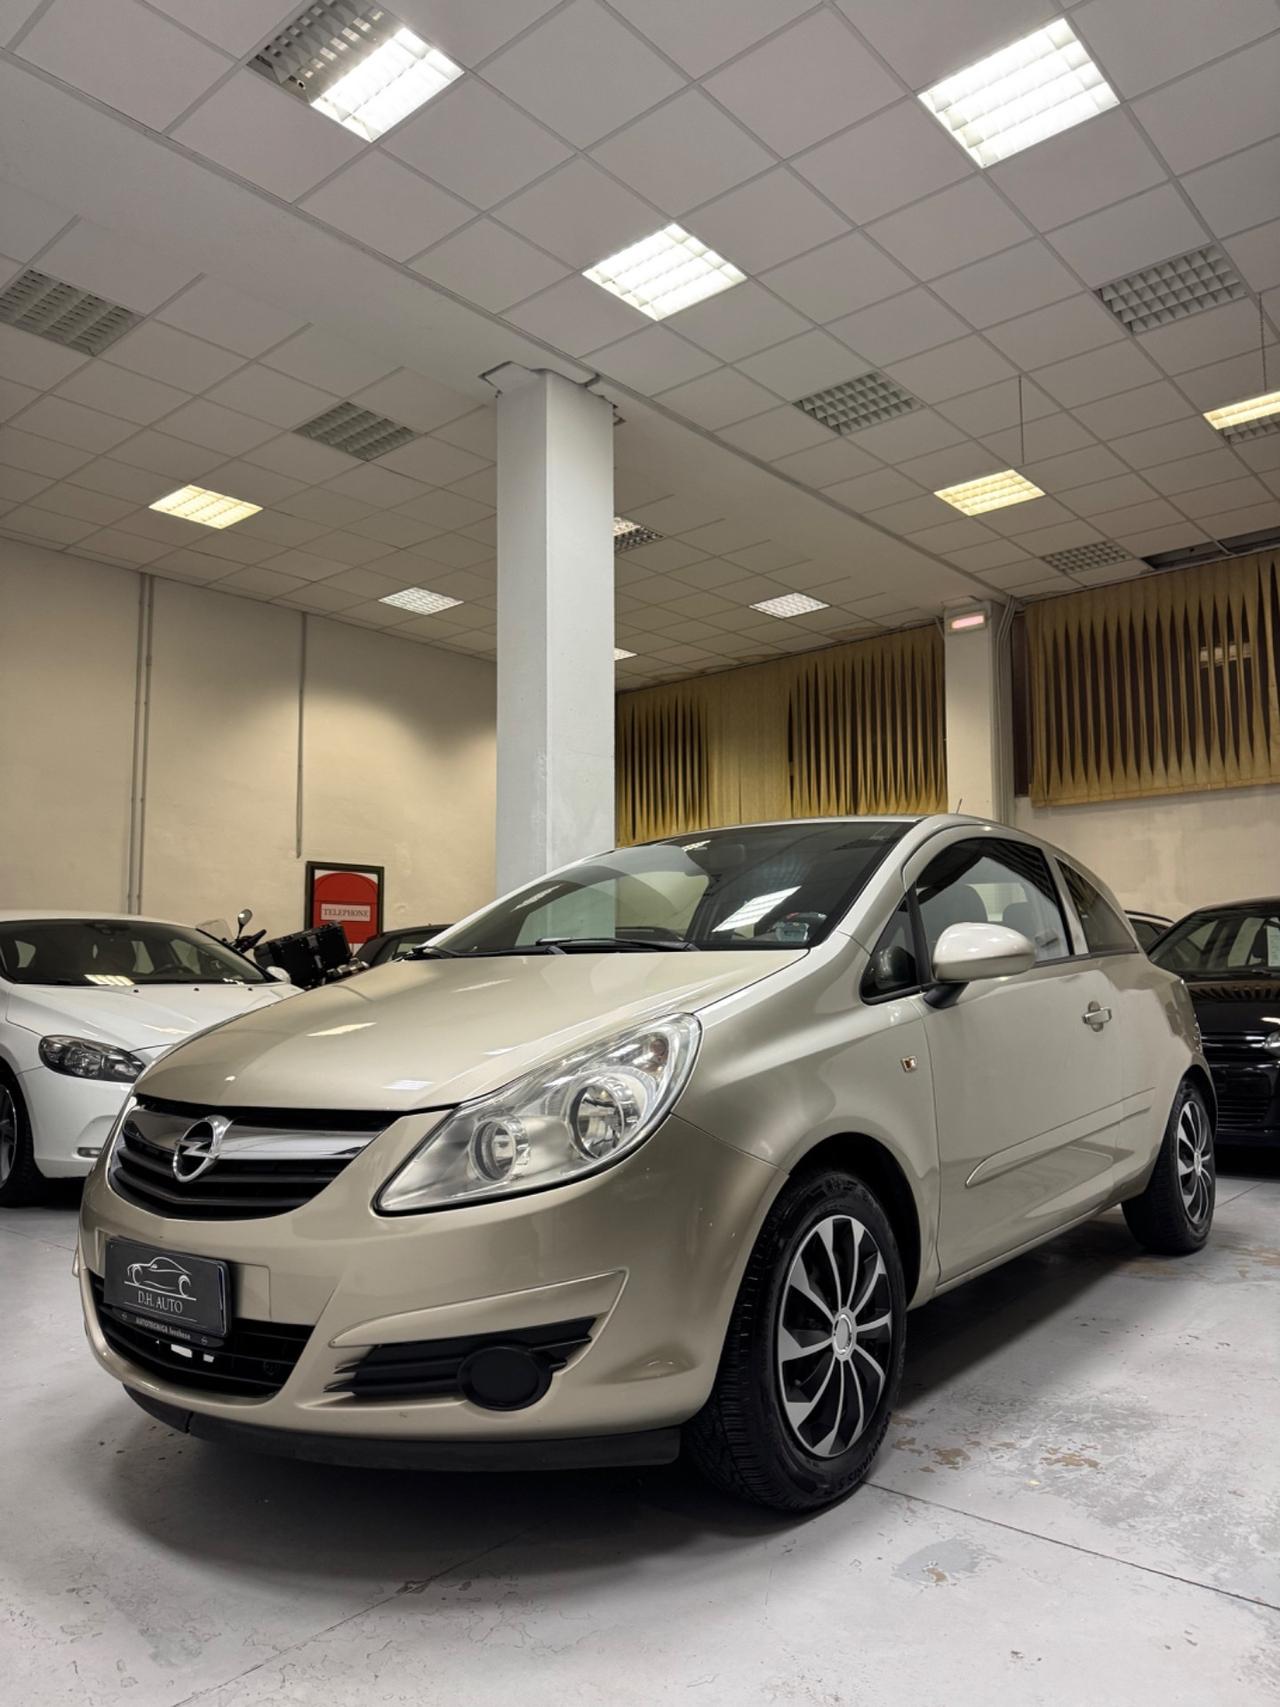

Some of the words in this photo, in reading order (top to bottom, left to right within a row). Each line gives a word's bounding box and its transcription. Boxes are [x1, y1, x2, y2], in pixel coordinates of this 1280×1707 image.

[323, 908, 368, 918] TELEPHONE
[138, 1290, 154, 1307] D.H.
[156, 1296, 183, 1313] AUTO
